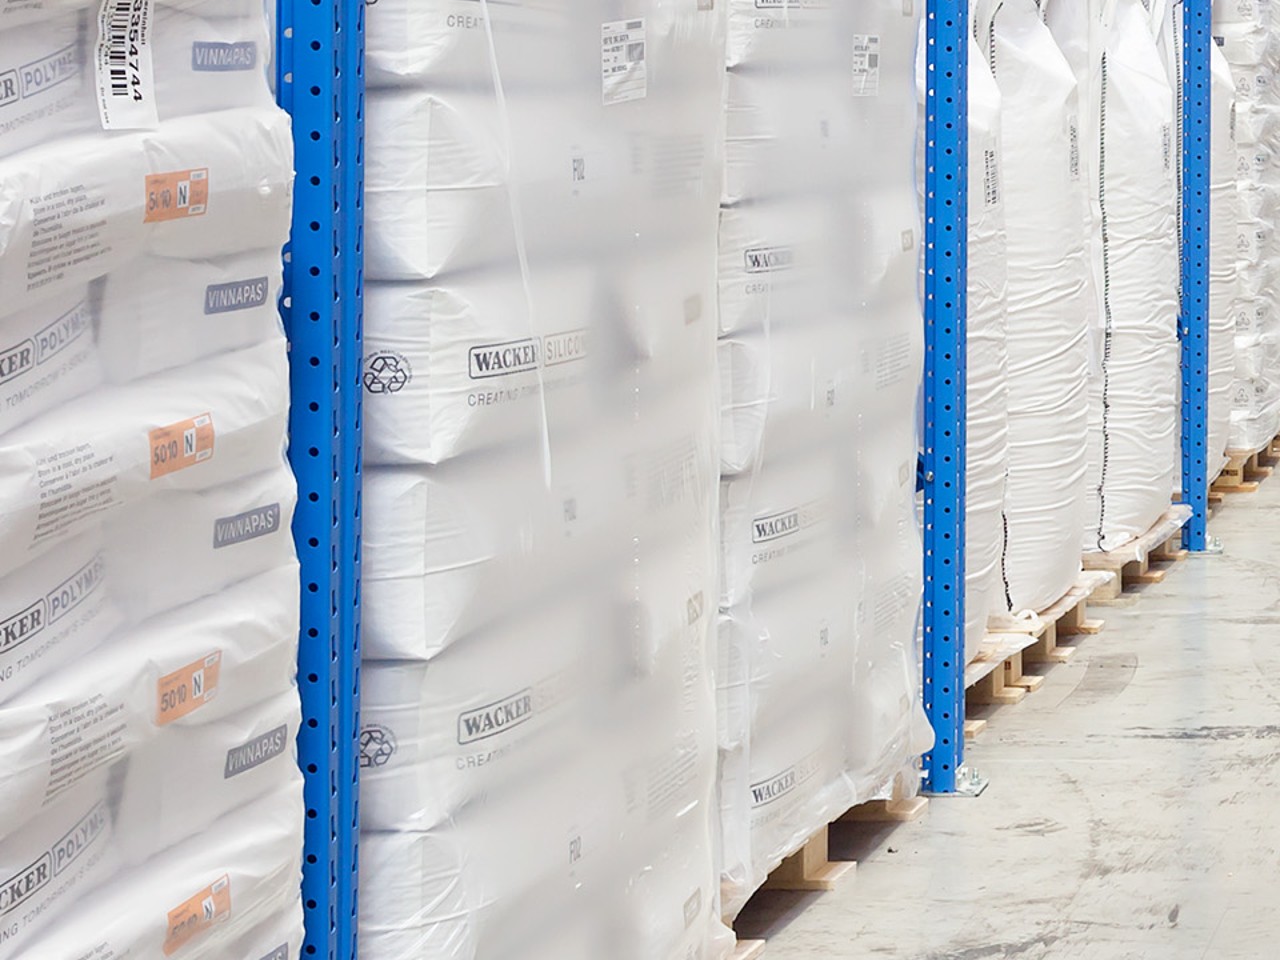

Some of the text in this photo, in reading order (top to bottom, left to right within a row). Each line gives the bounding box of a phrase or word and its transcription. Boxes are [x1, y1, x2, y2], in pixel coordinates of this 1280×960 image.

[194, 46, 253, 66] VINNAPAS
[177, 185, 188, 207] N
[208, 283, 263, 310] VINNAPAS
[153, 432, 194, 465] 5010 N
[216, 509, 275, 542] VINNAPAS
[160, 672, 203, 713] 5010 N
[464, 695, 532, 738] WACKER
[228, 732, 283, 773] VINNAPAS
